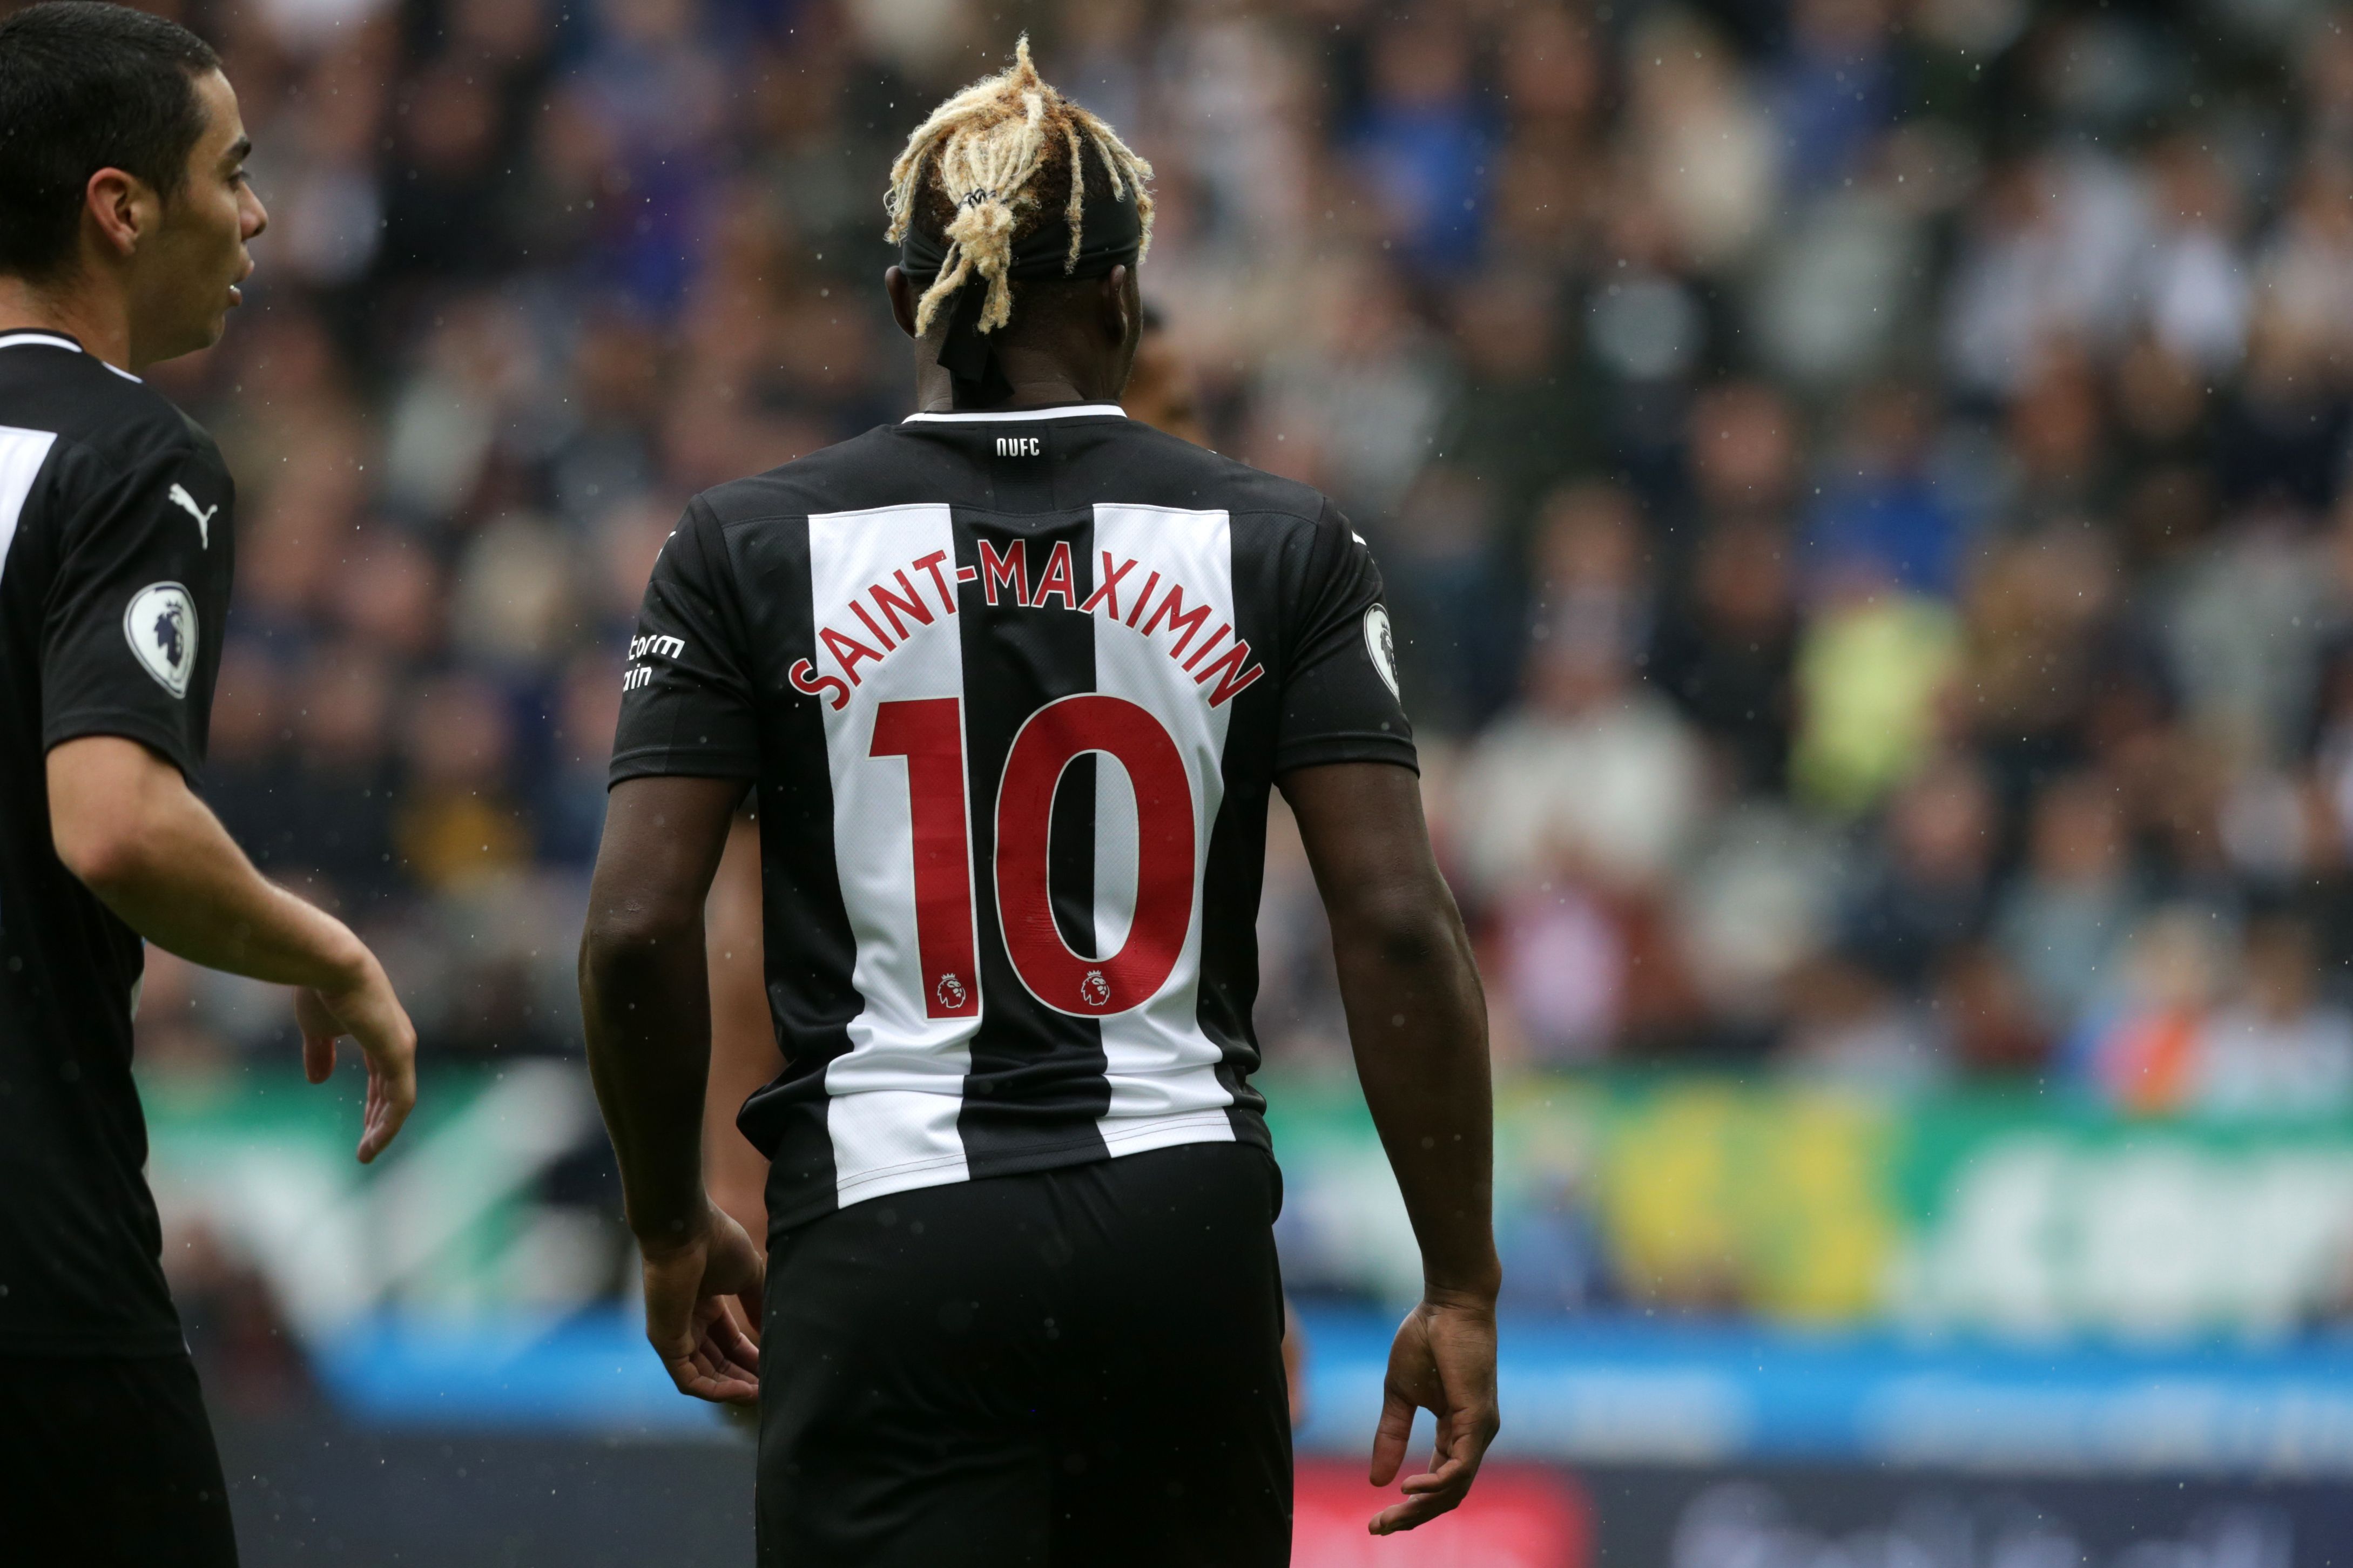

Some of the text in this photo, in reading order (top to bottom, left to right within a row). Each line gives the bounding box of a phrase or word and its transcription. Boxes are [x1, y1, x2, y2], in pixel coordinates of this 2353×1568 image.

[996, 438, 1040, 456] NUFC
[788, 538, 1265, 711] SAINT-MAXIMIN
[626, 634, 685, 661] torm
[623, 663, 652, 692] ain
[865, 692, 1196, 1023] 10
